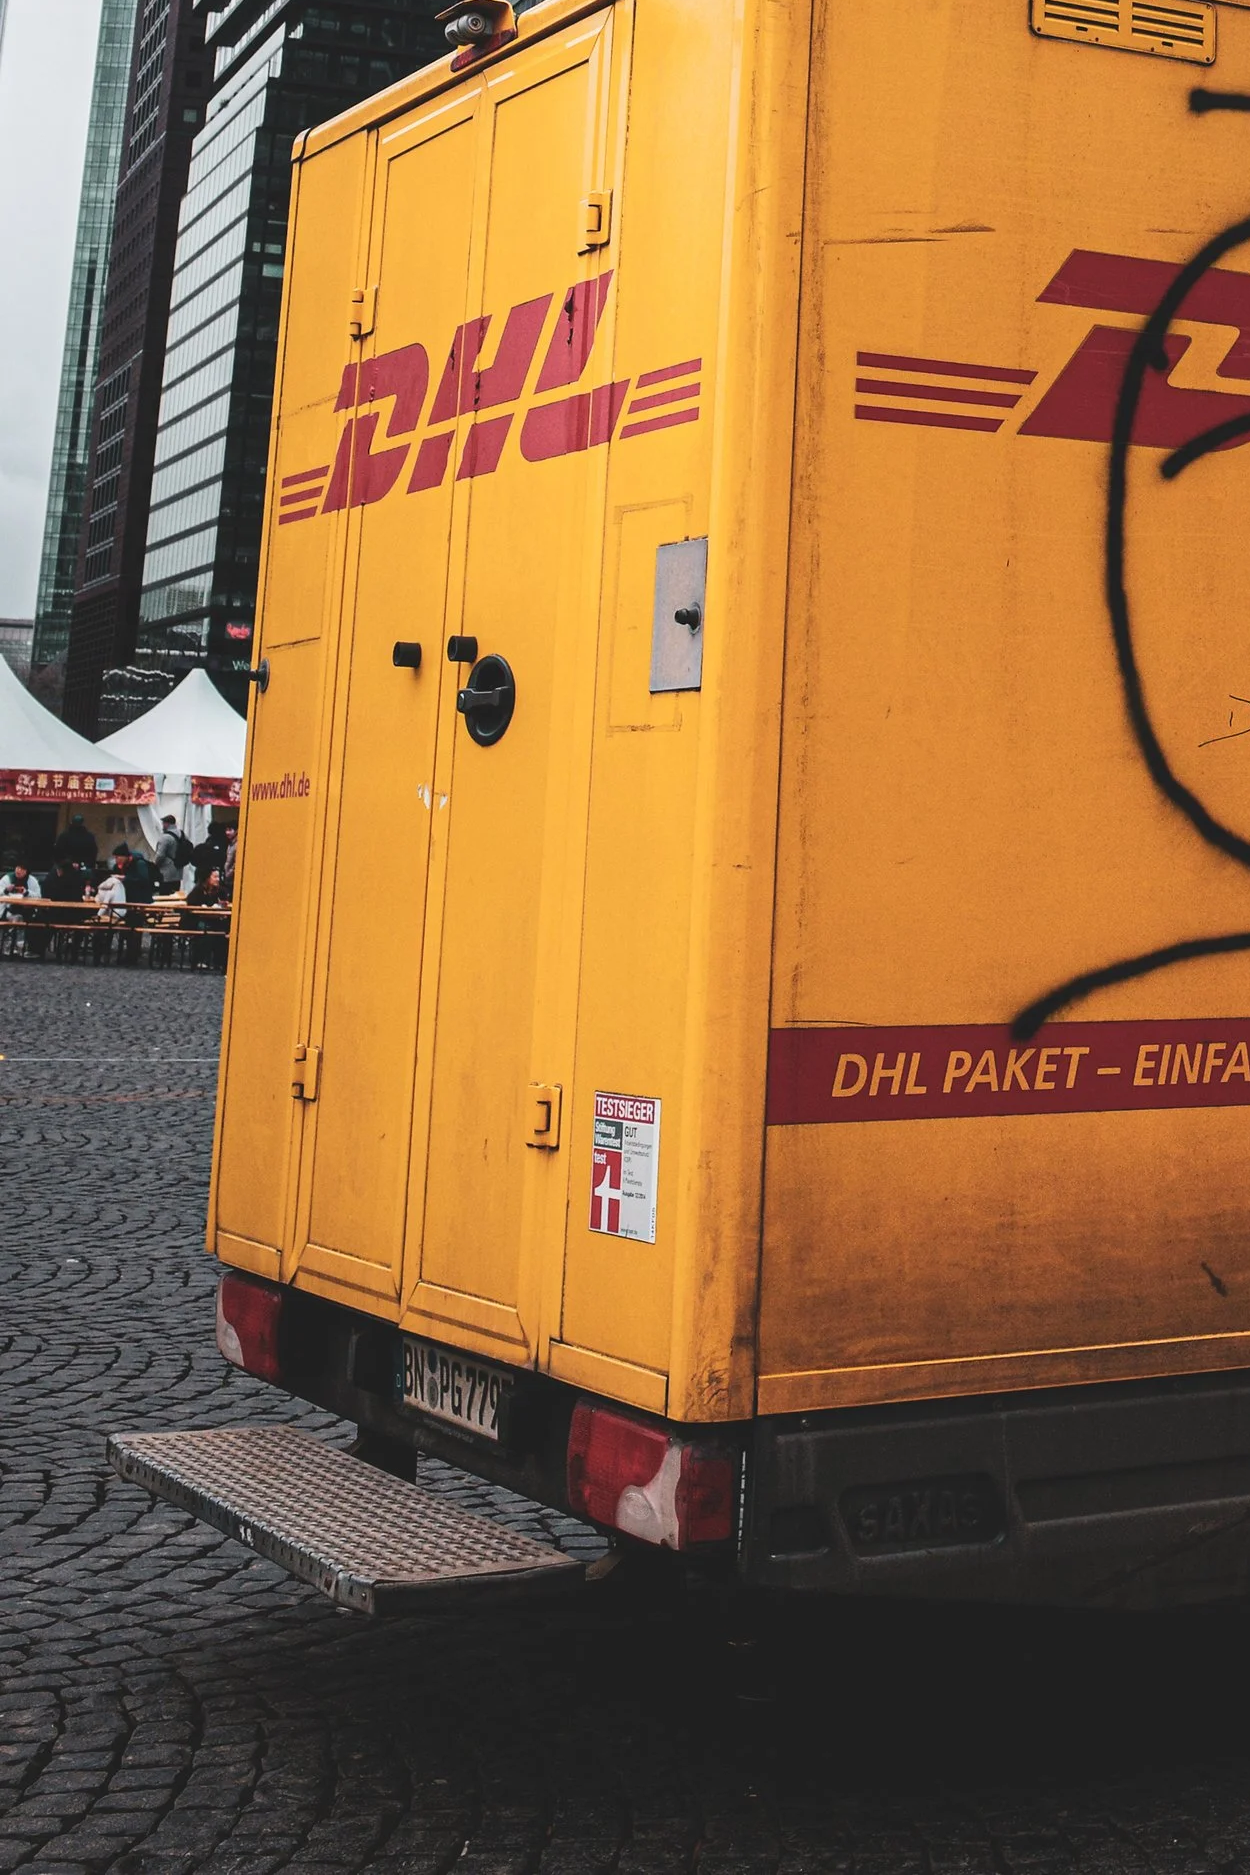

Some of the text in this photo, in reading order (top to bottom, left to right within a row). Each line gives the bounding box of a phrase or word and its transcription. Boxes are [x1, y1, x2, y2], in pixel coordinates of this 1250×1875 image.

[321, 269, 631, 515] DHL
[252, 771, 310, 802] www.dhl.de
[831, 1051, 927, 1097] DHL
[942, 1046, 1090, 1093] PAKET
[596, 1096, 654, 1122] TESTSIEGER
[624, 1126, 637, 1138] GUT
[404, 1343, 424, 1402] BN
[440, 1355, 462, 1418] PG
